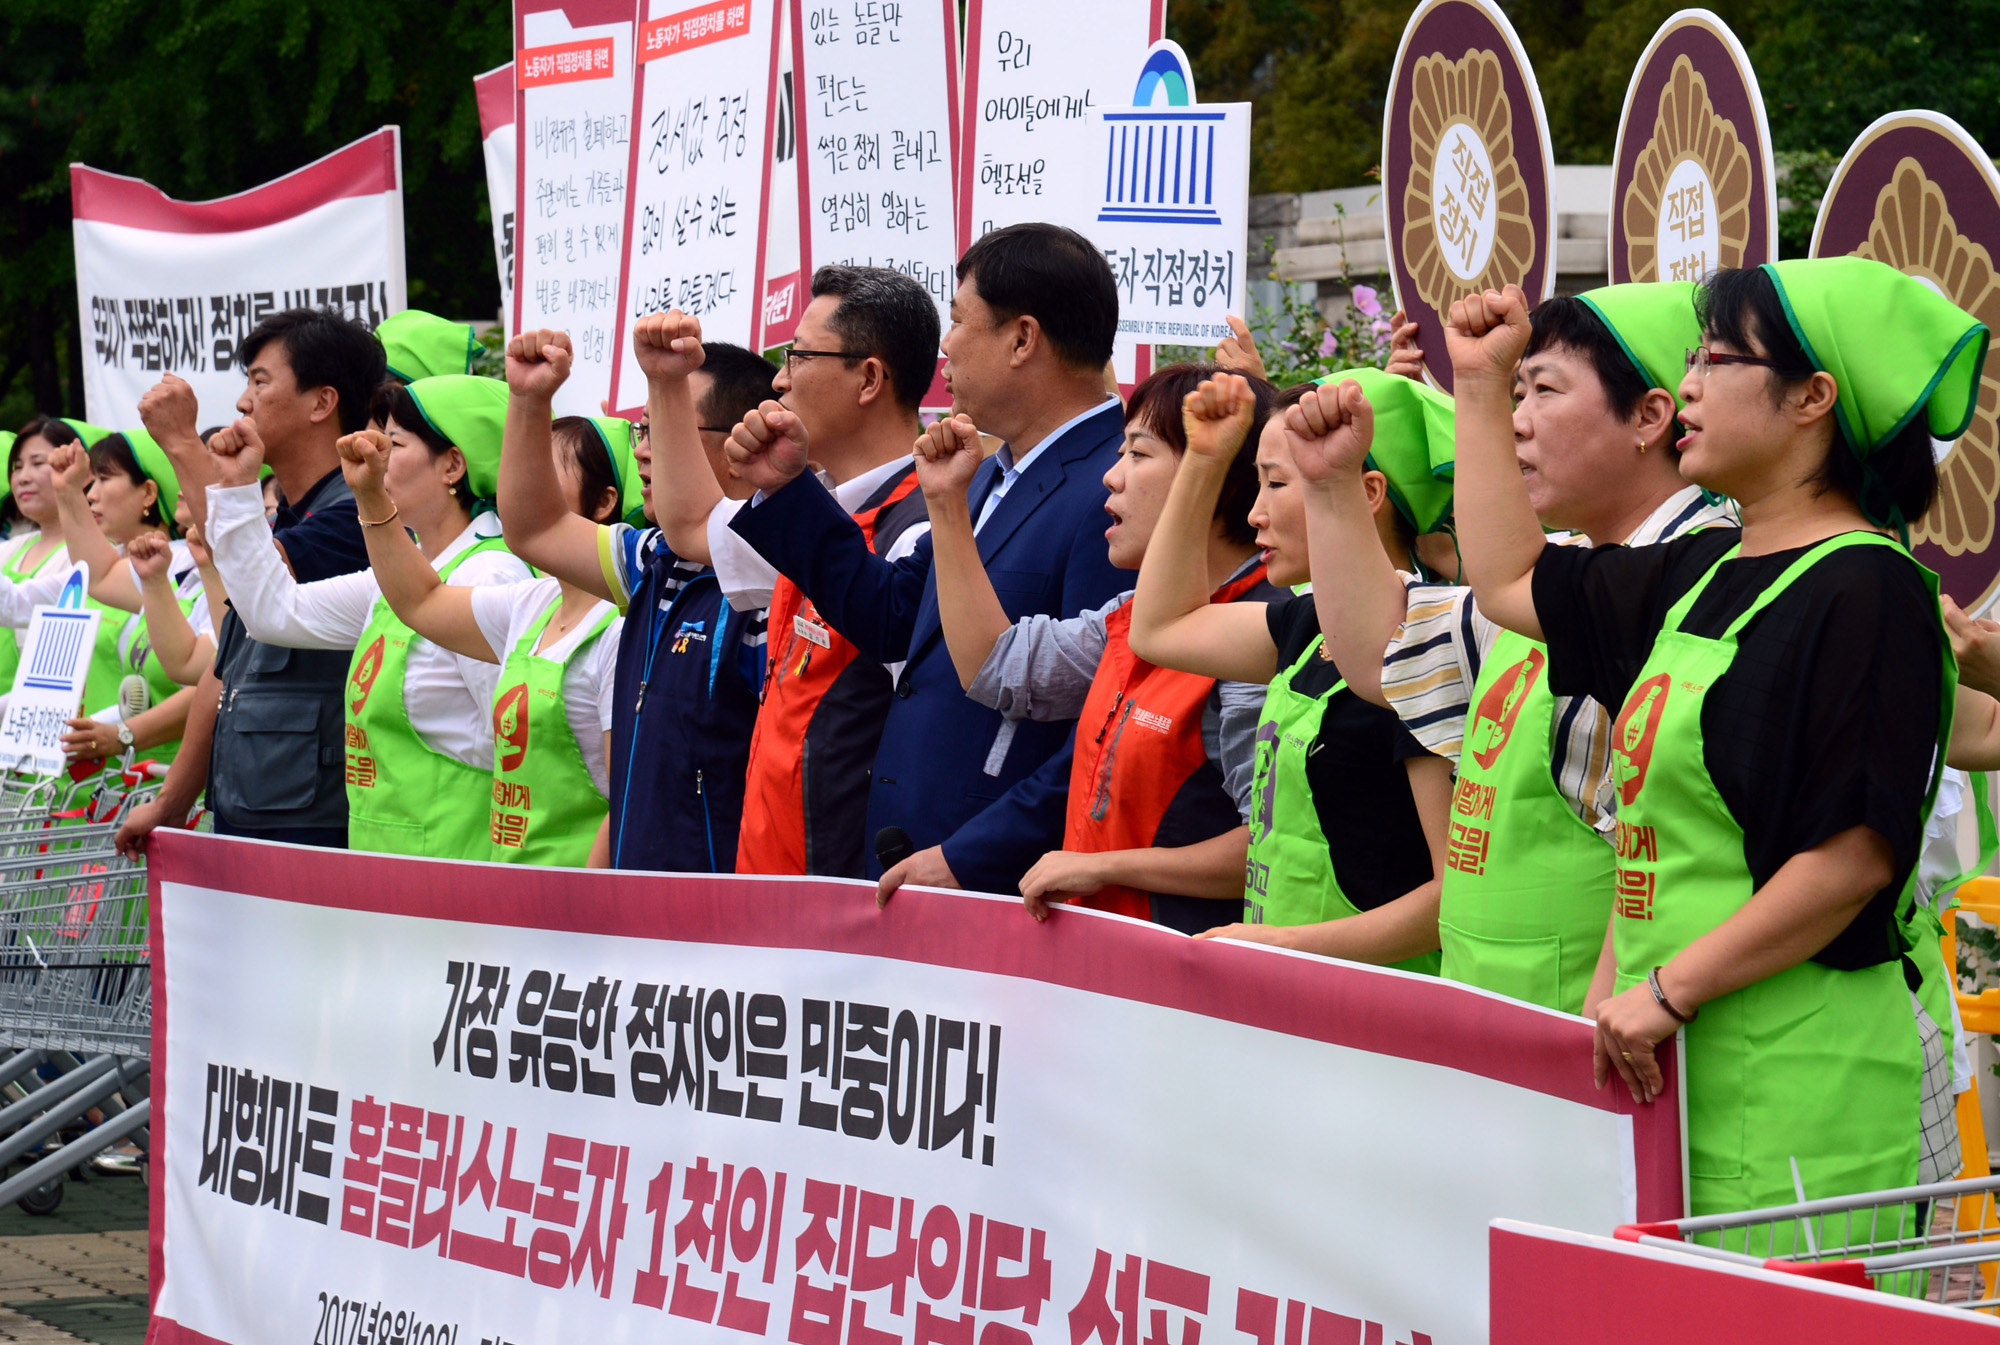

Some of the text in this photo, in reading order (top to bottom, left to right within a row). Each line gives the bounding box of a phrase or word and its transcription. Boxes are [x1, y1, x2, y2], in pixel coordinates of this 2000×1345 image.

[646, 3, 745, 51] 노동자가 직접정치를 하면
[810, 2, 903, 46] 있는 놈들만
[524, 46, 609, 78] 노동자가 직접정치를 하면
[998, 30, 1031, 72] 우리
[534, 115, 577, 160] 비정규직
[717, 88, 749, 164] 걱정
[817, 130, 942, 175] 썩은 정치 끝내고
[981, 153, 1045, 196] 헬조선을
[1451, 131, 1491, 222] 직접
[641, 200, 666, 256] 없이
[821, 190, 929, 235] 열심히 일하는
[1439, 184, 1479, 273] 정치
[1666, 180, 1705, 243] 직접
[124, 297, 206, 373] 직접하자!
[1145, 321, 1153, 334] OF
[1155, 321, 1167, 335] THE
[1168, 322, 1200, 337] REPUBLIC
[1201, 324, 1209, 337] OF
[433, 960, 1002, 1167] 가장 유능한 정치인은 민중이다!
[198, 1063, 339, 1225] 대형마트
[340, 1095, 630, 1299] 홈플러스노동자
[632, 1155, 788, 1336] 1천인
[788, 1177, 1052, 1345] 집단입당
